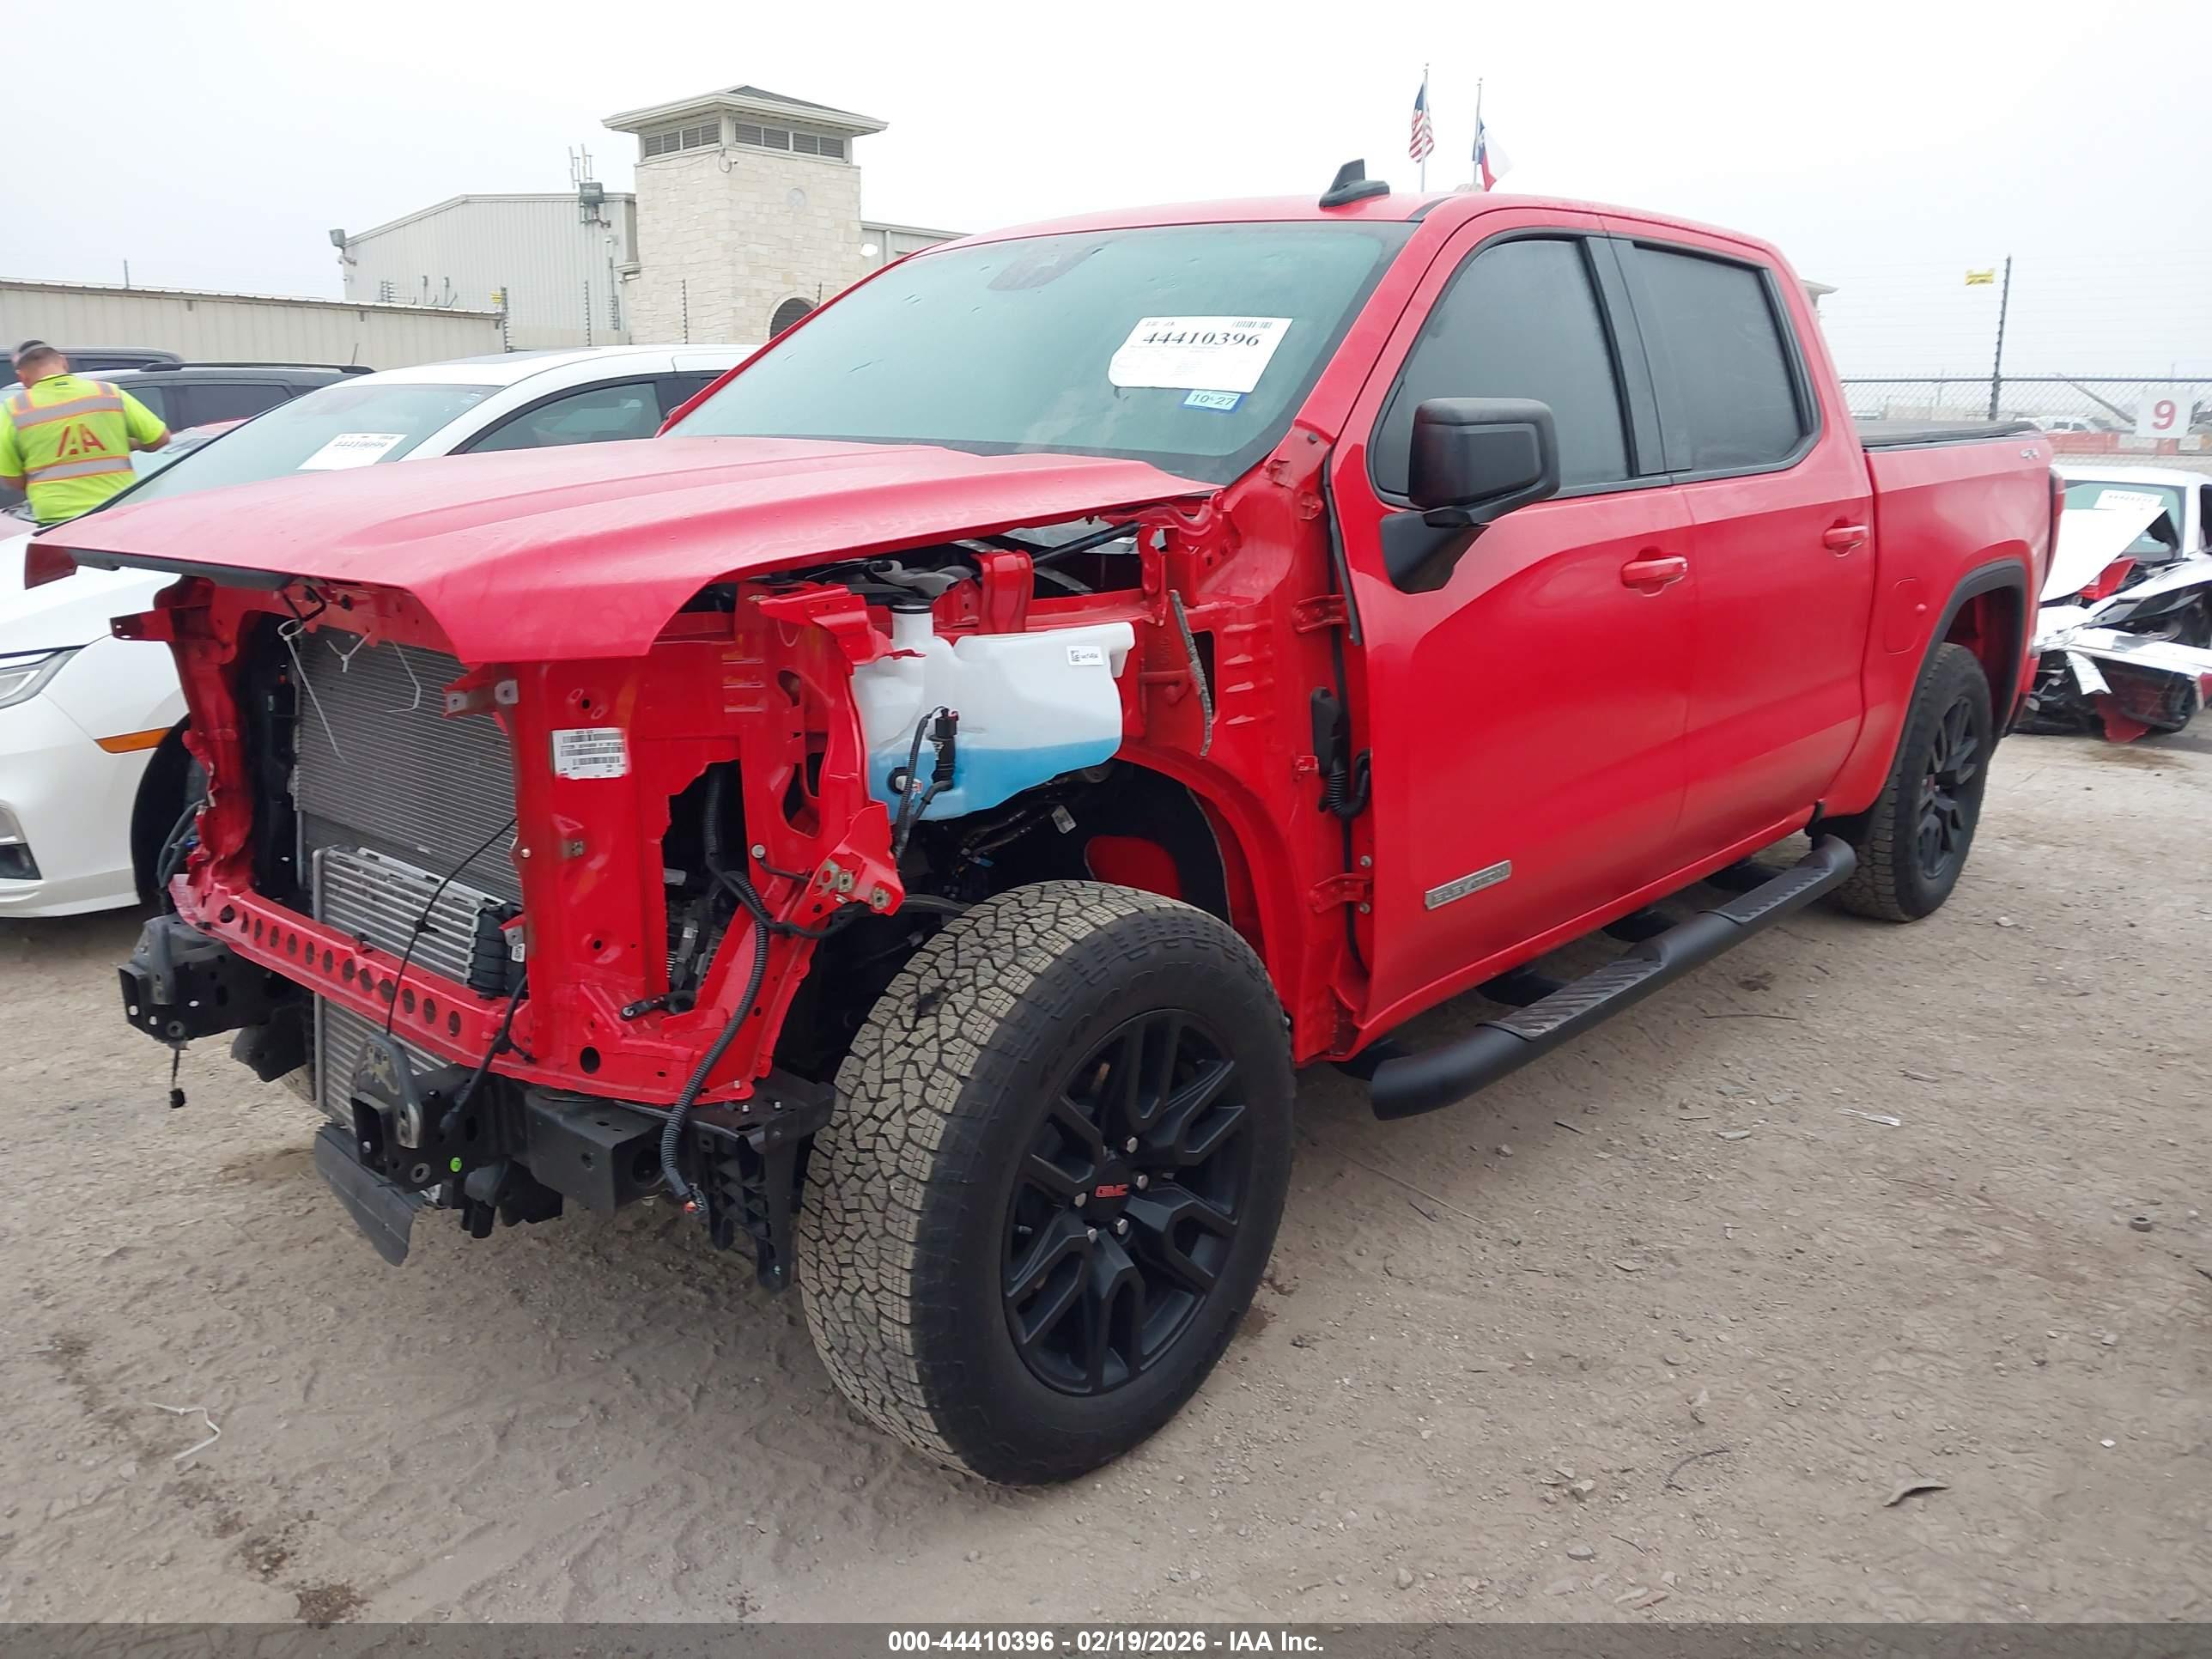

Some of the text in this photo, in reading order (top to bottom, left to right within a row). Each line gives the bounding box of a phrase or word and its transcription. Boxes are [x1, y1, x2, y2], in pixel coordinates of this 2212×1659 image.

[1142, 331, 1265, 348] 44410396
[1214, 397, 1236, 406] 27
[2152, 399, 2176, 430] 9
